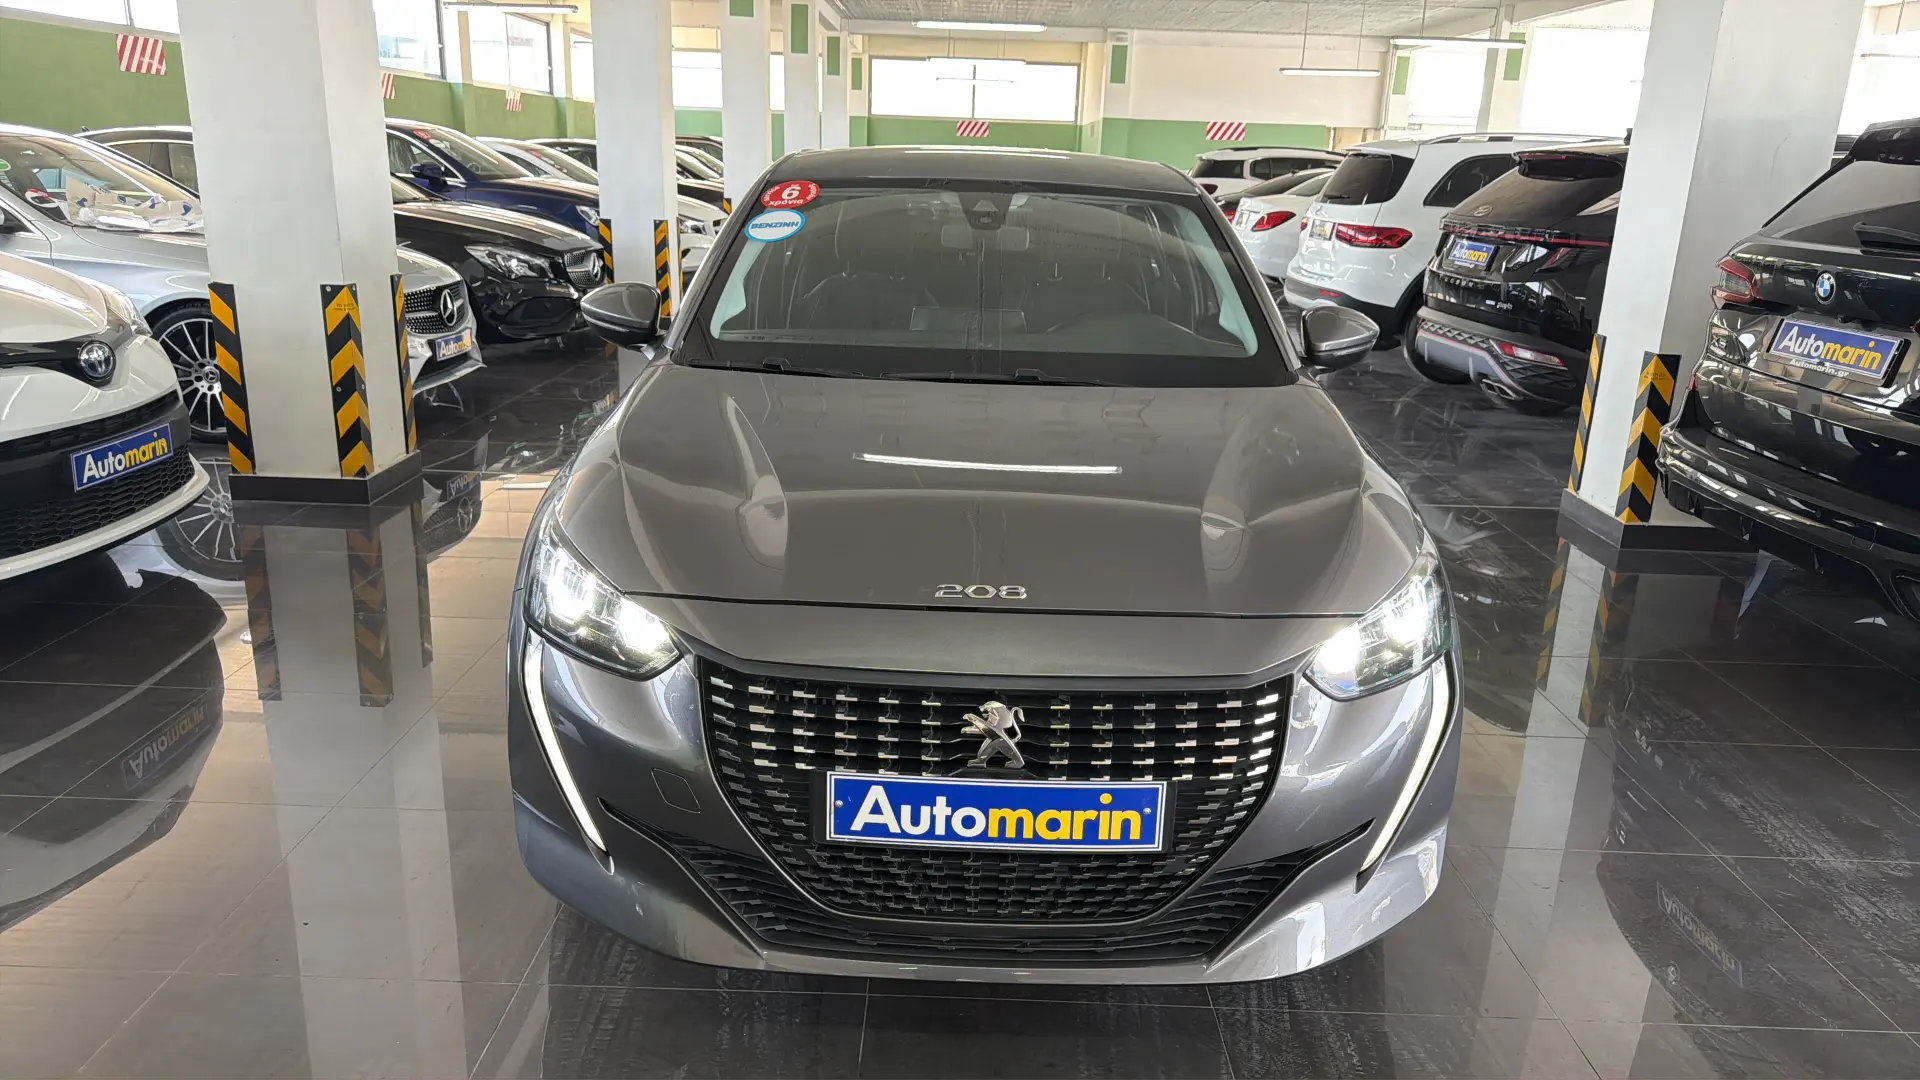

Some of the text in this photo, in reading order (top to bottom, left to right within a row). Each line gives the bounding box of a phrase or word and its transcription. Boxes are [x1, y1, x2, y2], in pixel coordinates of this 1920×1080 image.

[768, 199, 804, 207] χρόνια
[781, 187, 801, 200] 6
[1779, 325, 1882, 371] Automarin
[1789, 359, 1850, 378] Automarin.gr
[83, 431, 168, 484] Automarin
[934, 583, 1028, 600] 208
[850, 785, 1142, 841] Automarin
